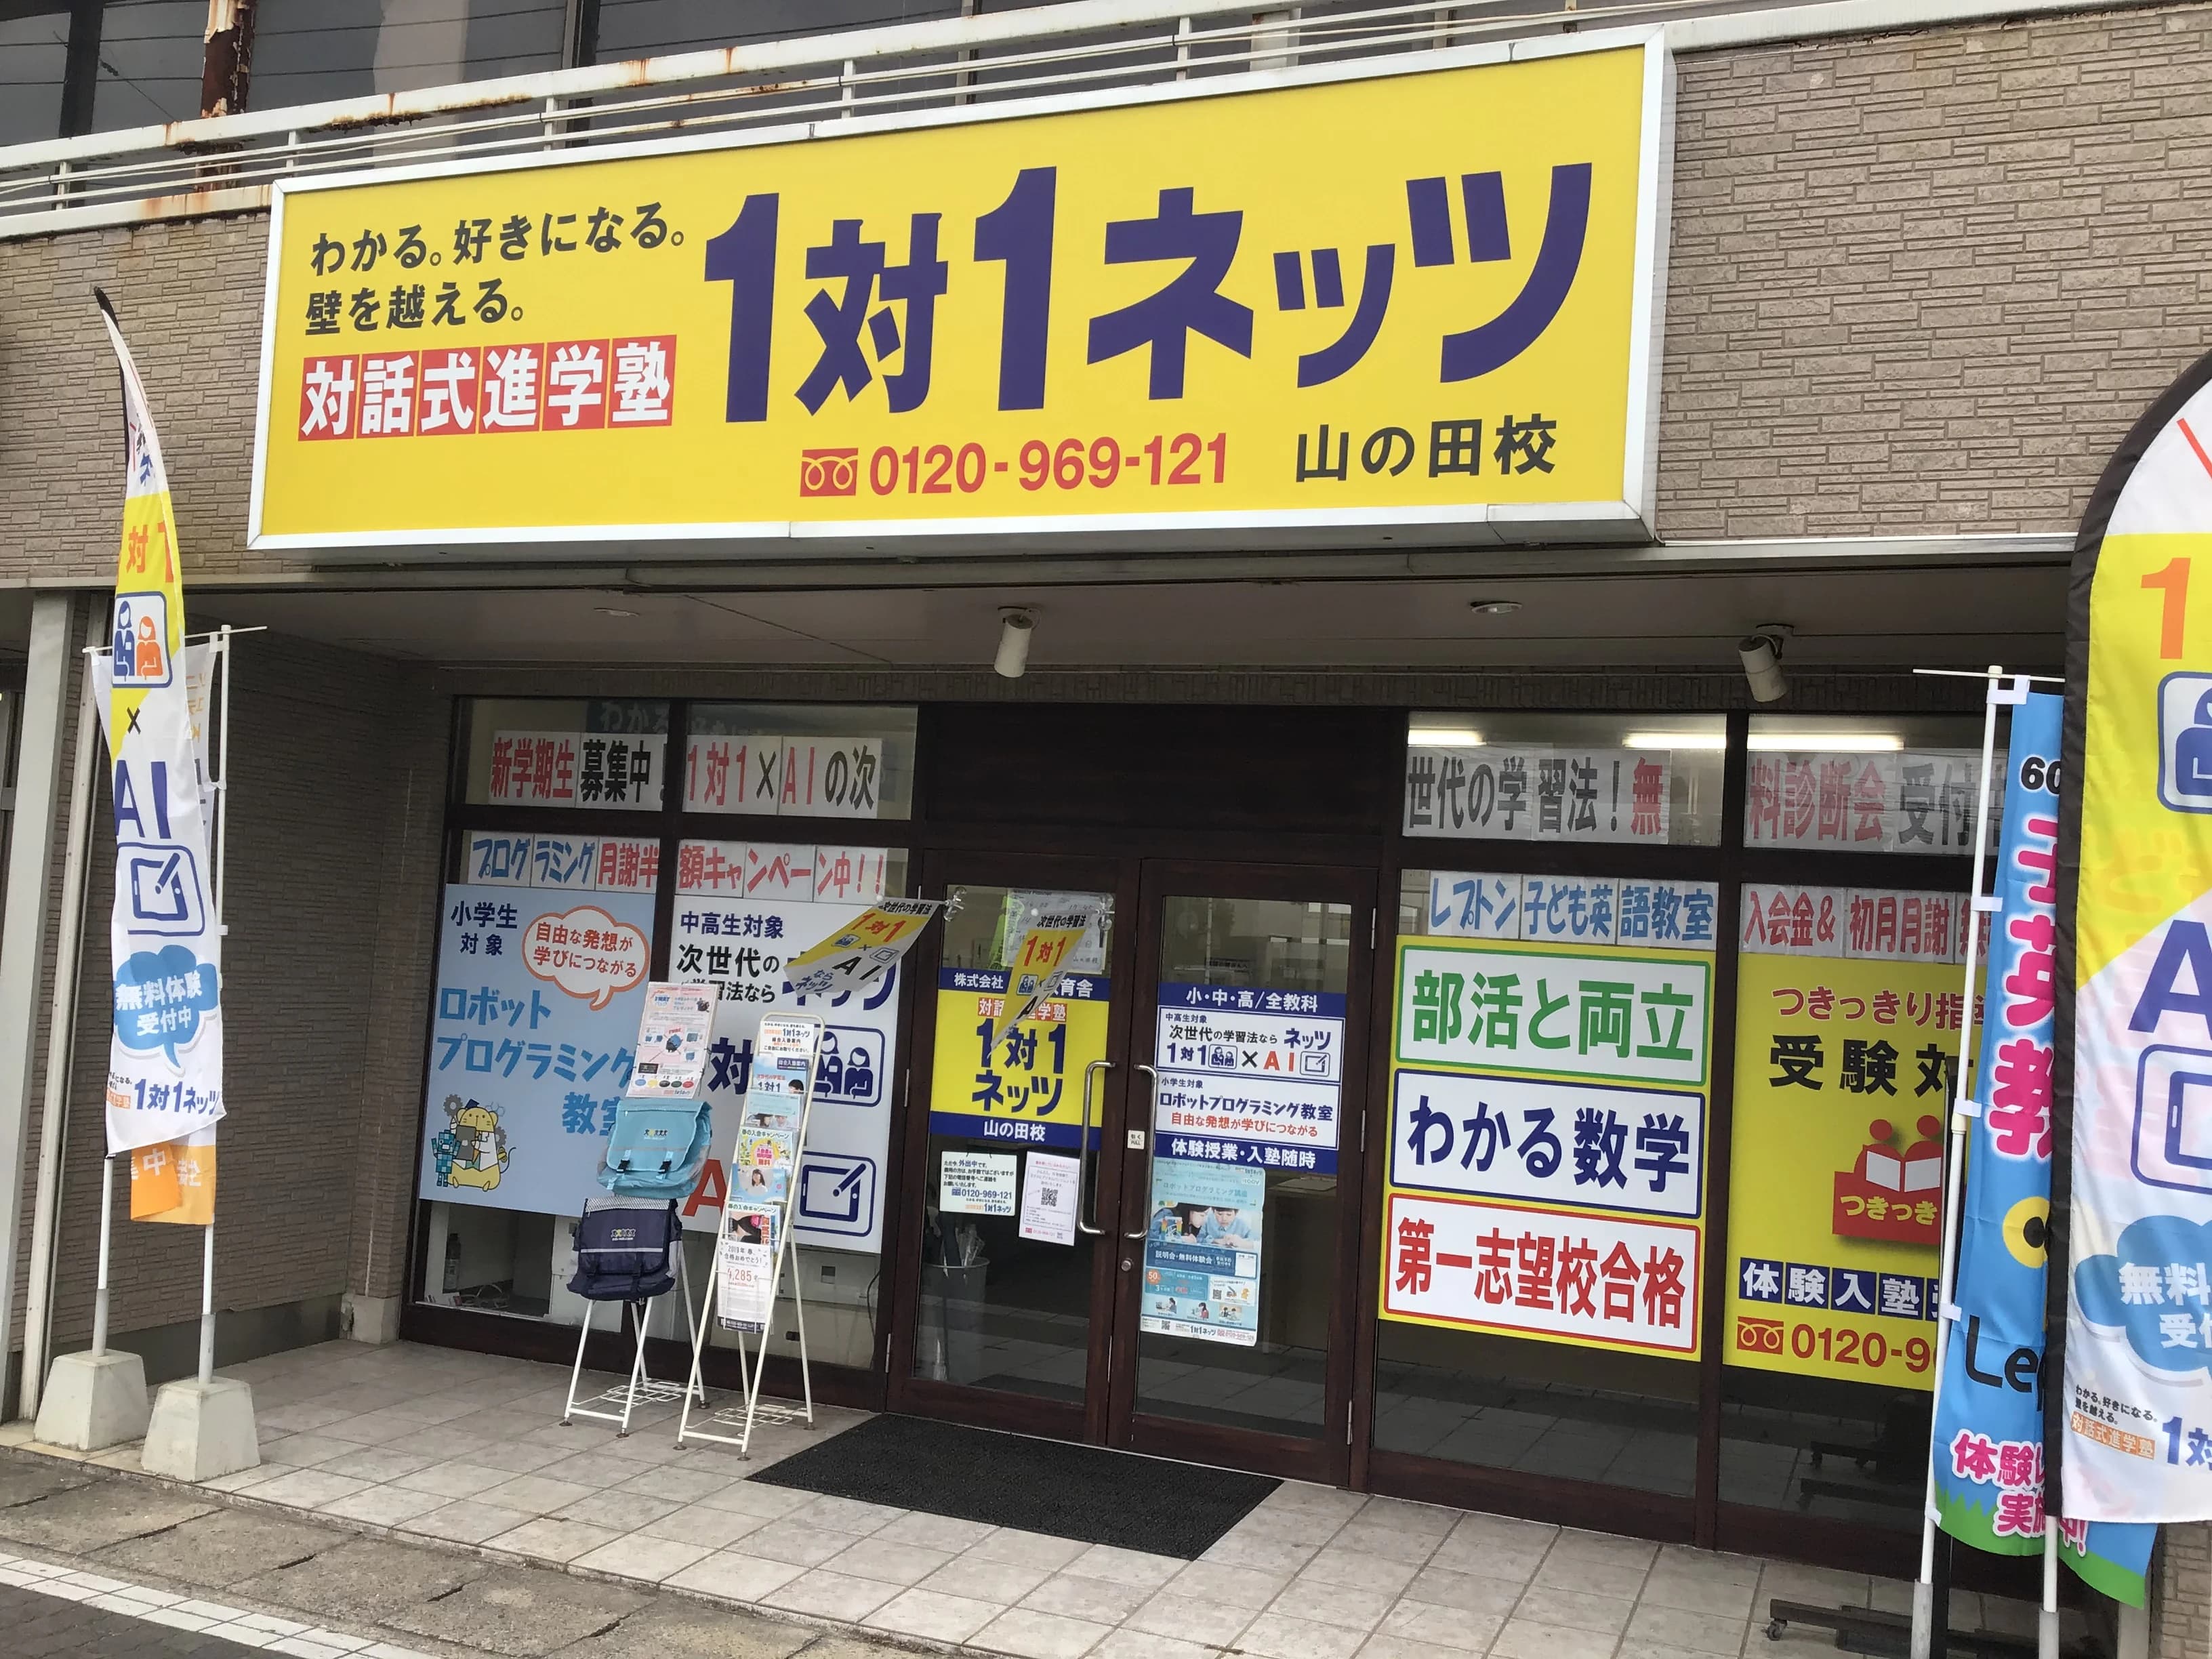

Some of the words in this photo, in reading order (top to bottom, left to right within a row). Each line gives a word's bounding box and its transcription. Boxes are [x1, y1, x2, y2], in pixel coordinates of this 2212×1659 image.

[310, 201, 685, 276] わかる。好きになる。
[305, 279, 525, 335] 壁を越える。
[705, 163, 1592, 423] 1対1ネッツ
[301, 341, 671, 436] 対話式進学塾
[869, 432, 1227, 495] 0120-969-121
[1296, 413, 1557, 483] 山の田校
[451, 901, 518, 928] 小学生
[680, 911, 784, 939] 中高生対象
[852, 912, 907, 943] 1対1
[459, 933, 503, 956] 対象
[535, 922, 634, 951] 自由な発想が
[1023, 935, 1067, 966] 1対1
[533, 945, 638, 977] 学びにつながる
[676, 943, 780, 978] 次世代の
[116, 969, 202, 1011] 無料体験
[954, 972, 1004, 989] 株式会社
[1050, 978, 1094, 998] 育舎
[137, 1006, 192, 1037] 受付中
[439, 986, 551, 1029] ロボット
[1165, 1012, 1208, 1024] 中高生対象
[1412, 969, 1694, 1062] 部活と両立
[977, 1018, 1067, 1074] 1対1
[1169, 1025, 1278, 1044] 次世代の学習法なら
[1284, 1027, 1332, 1051] ネッツ
[437, 1033, 636, 1089] プログラミング
[134, 1078, 220, 1116] 1対1ネッツ
[972, 1069, 1063, 1116] ネッツ
[1161, 1077, 1204, 1089] 小学生対象
[1160, 1092, 1334, 1122] ロボットプログラミング教室
[1171, 1111, 1318, 1137] 自由な発想が学びにつながる
[983, 1120, 1046, 1142] 山の田校
[1408, 1094, 1690, 1191] わかる数学
[962, 1189, 1012, 1200] 0120-969-121
[1395, 1216, 1687, 1331] 第一志望校合格
[1742, 1261, 1940, 1318] 体験入塾
[2118, 1262, 2211, 1306] 無料
[1791, 1323, 1936, 1374] 0120-9
[2070, 1412, 2154, 1459] 対話式進学塾
